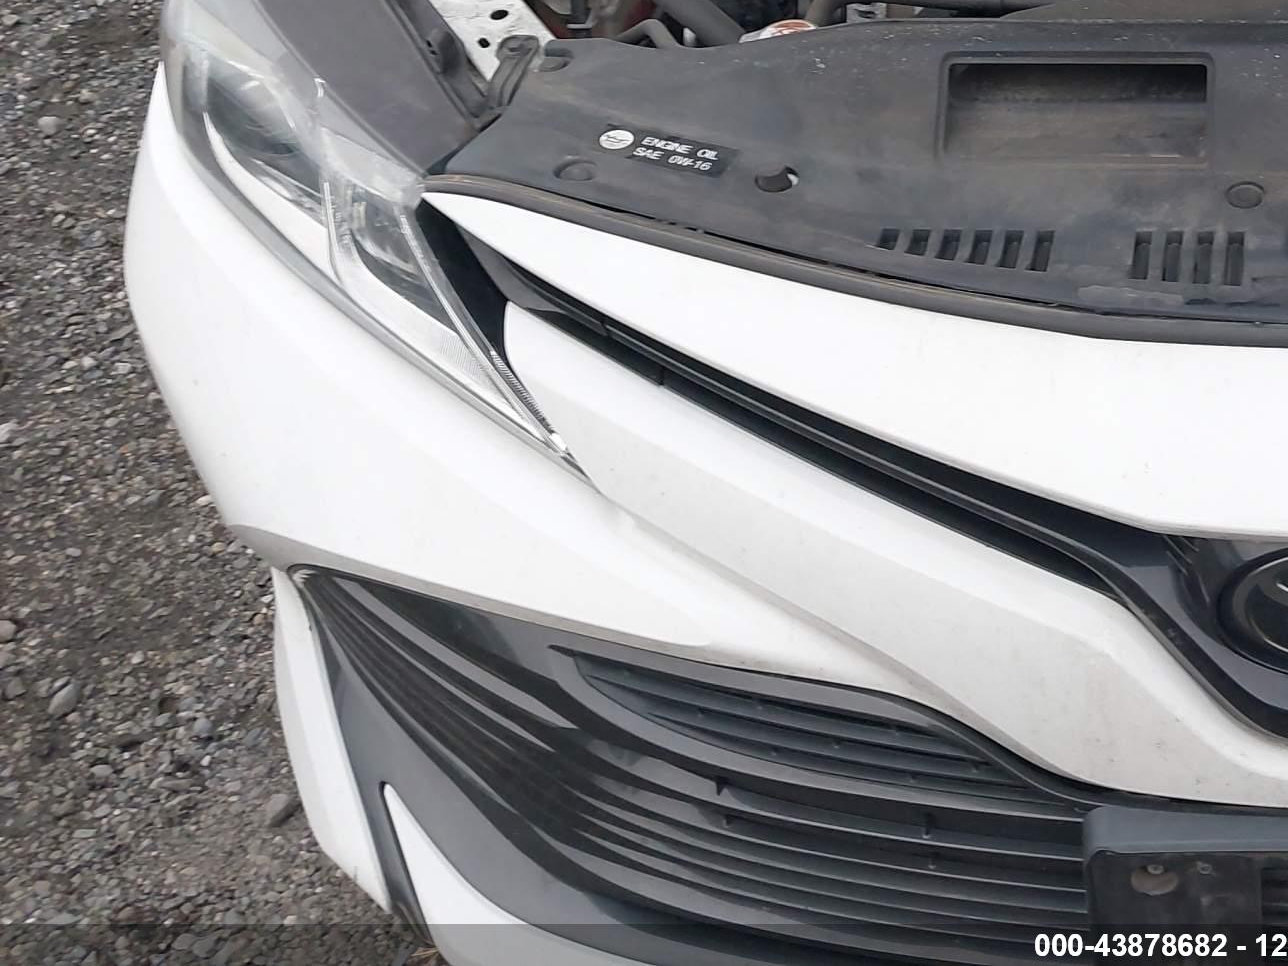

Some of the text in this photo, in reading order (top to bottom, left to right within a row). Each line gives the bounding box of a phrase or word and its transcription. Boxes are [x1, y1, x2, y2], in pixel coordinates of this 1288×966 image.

[632, 147, 712, 171] SAE 0W-16
[641, 136, 718, 160] ENGINE OIL
